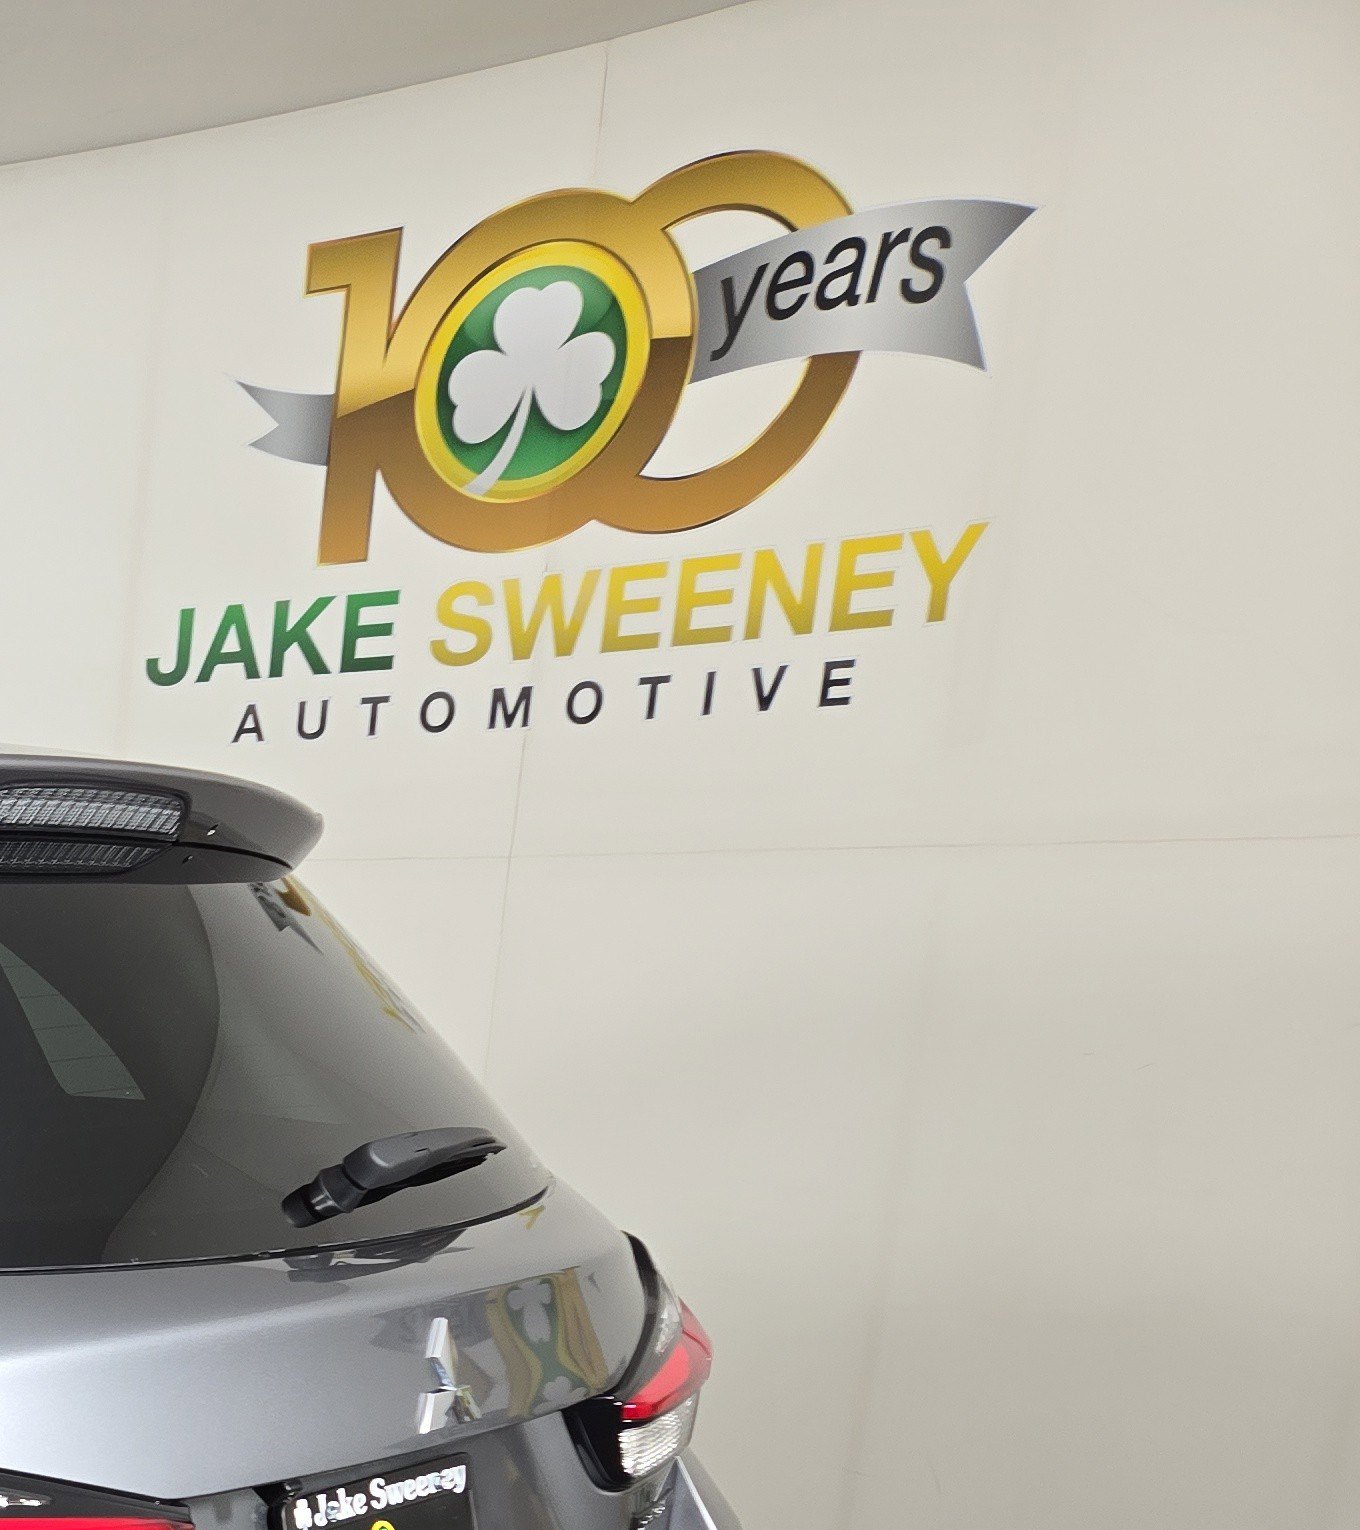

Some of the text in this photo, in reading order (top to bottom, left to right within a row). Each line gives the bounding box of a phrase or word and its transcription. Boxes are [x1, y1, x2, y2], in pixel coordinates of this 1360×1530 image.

[709, 223, 952, 362] years
[144, 522, 989, 688] JAKE SWEENEY
[232, 658, 857, 745] AUTOMOTIVE
[314, 1464, 467, 1527] Jake Sweeney
